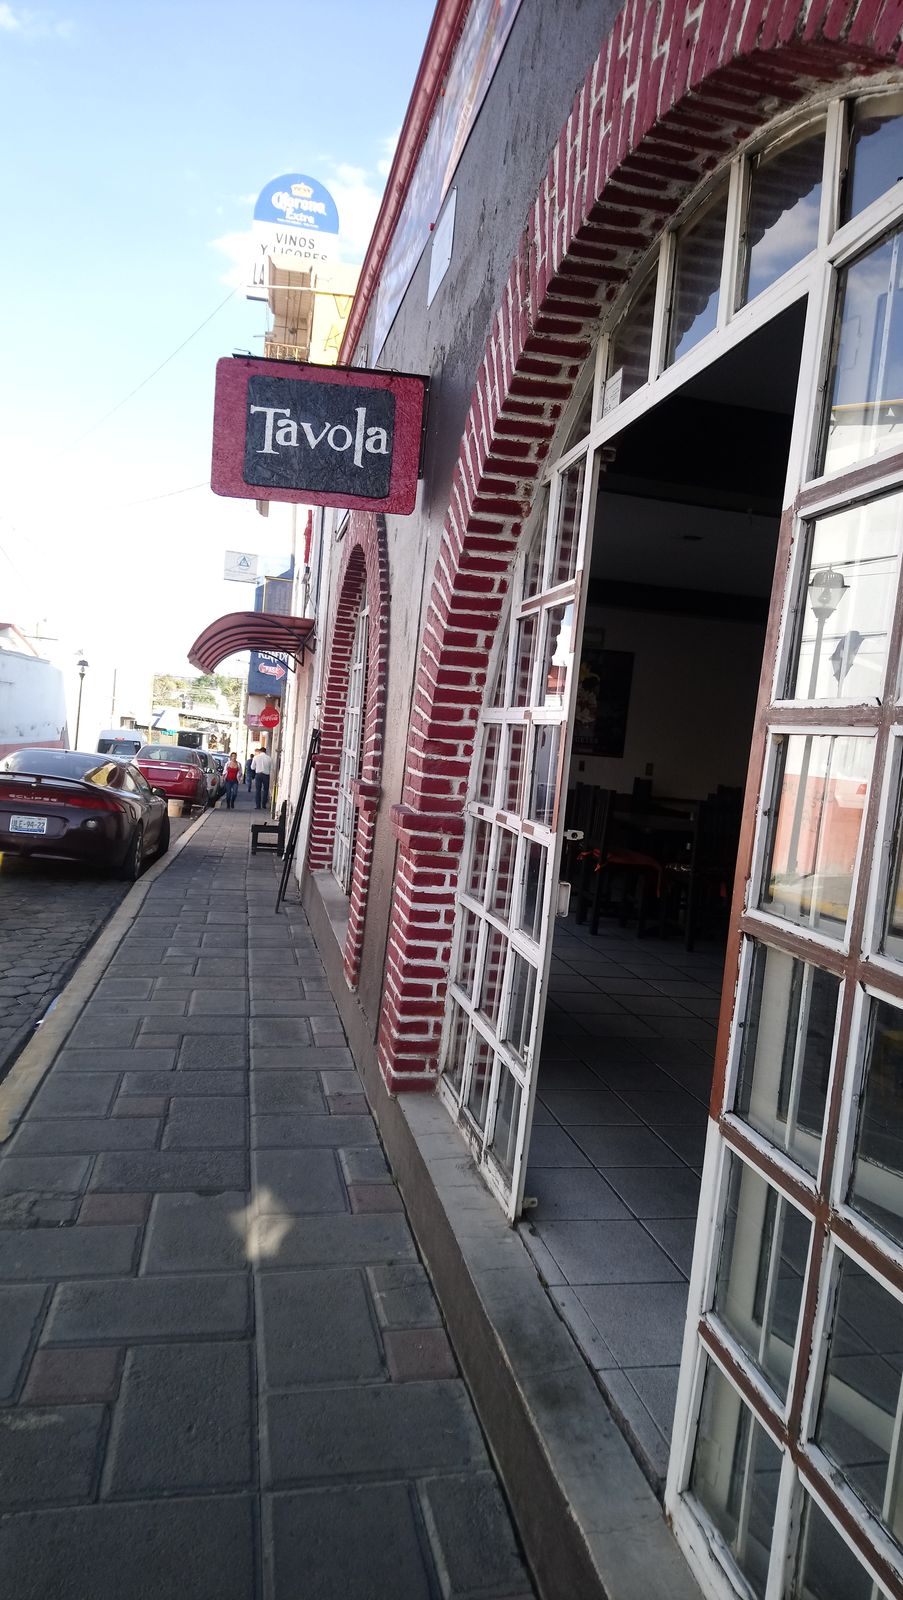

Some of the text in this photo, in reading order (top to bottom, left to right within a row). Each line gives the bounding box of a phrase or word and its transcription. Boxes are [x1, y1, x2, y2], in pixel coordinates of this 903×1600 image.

[271, 191, 327, 216] Corona
[285, 207, 315, 225] Extra
[260, 243, 269, 255] Y
[276, 232, 315, 250] VINOS
[250, 404, 390, 469] Tavola
